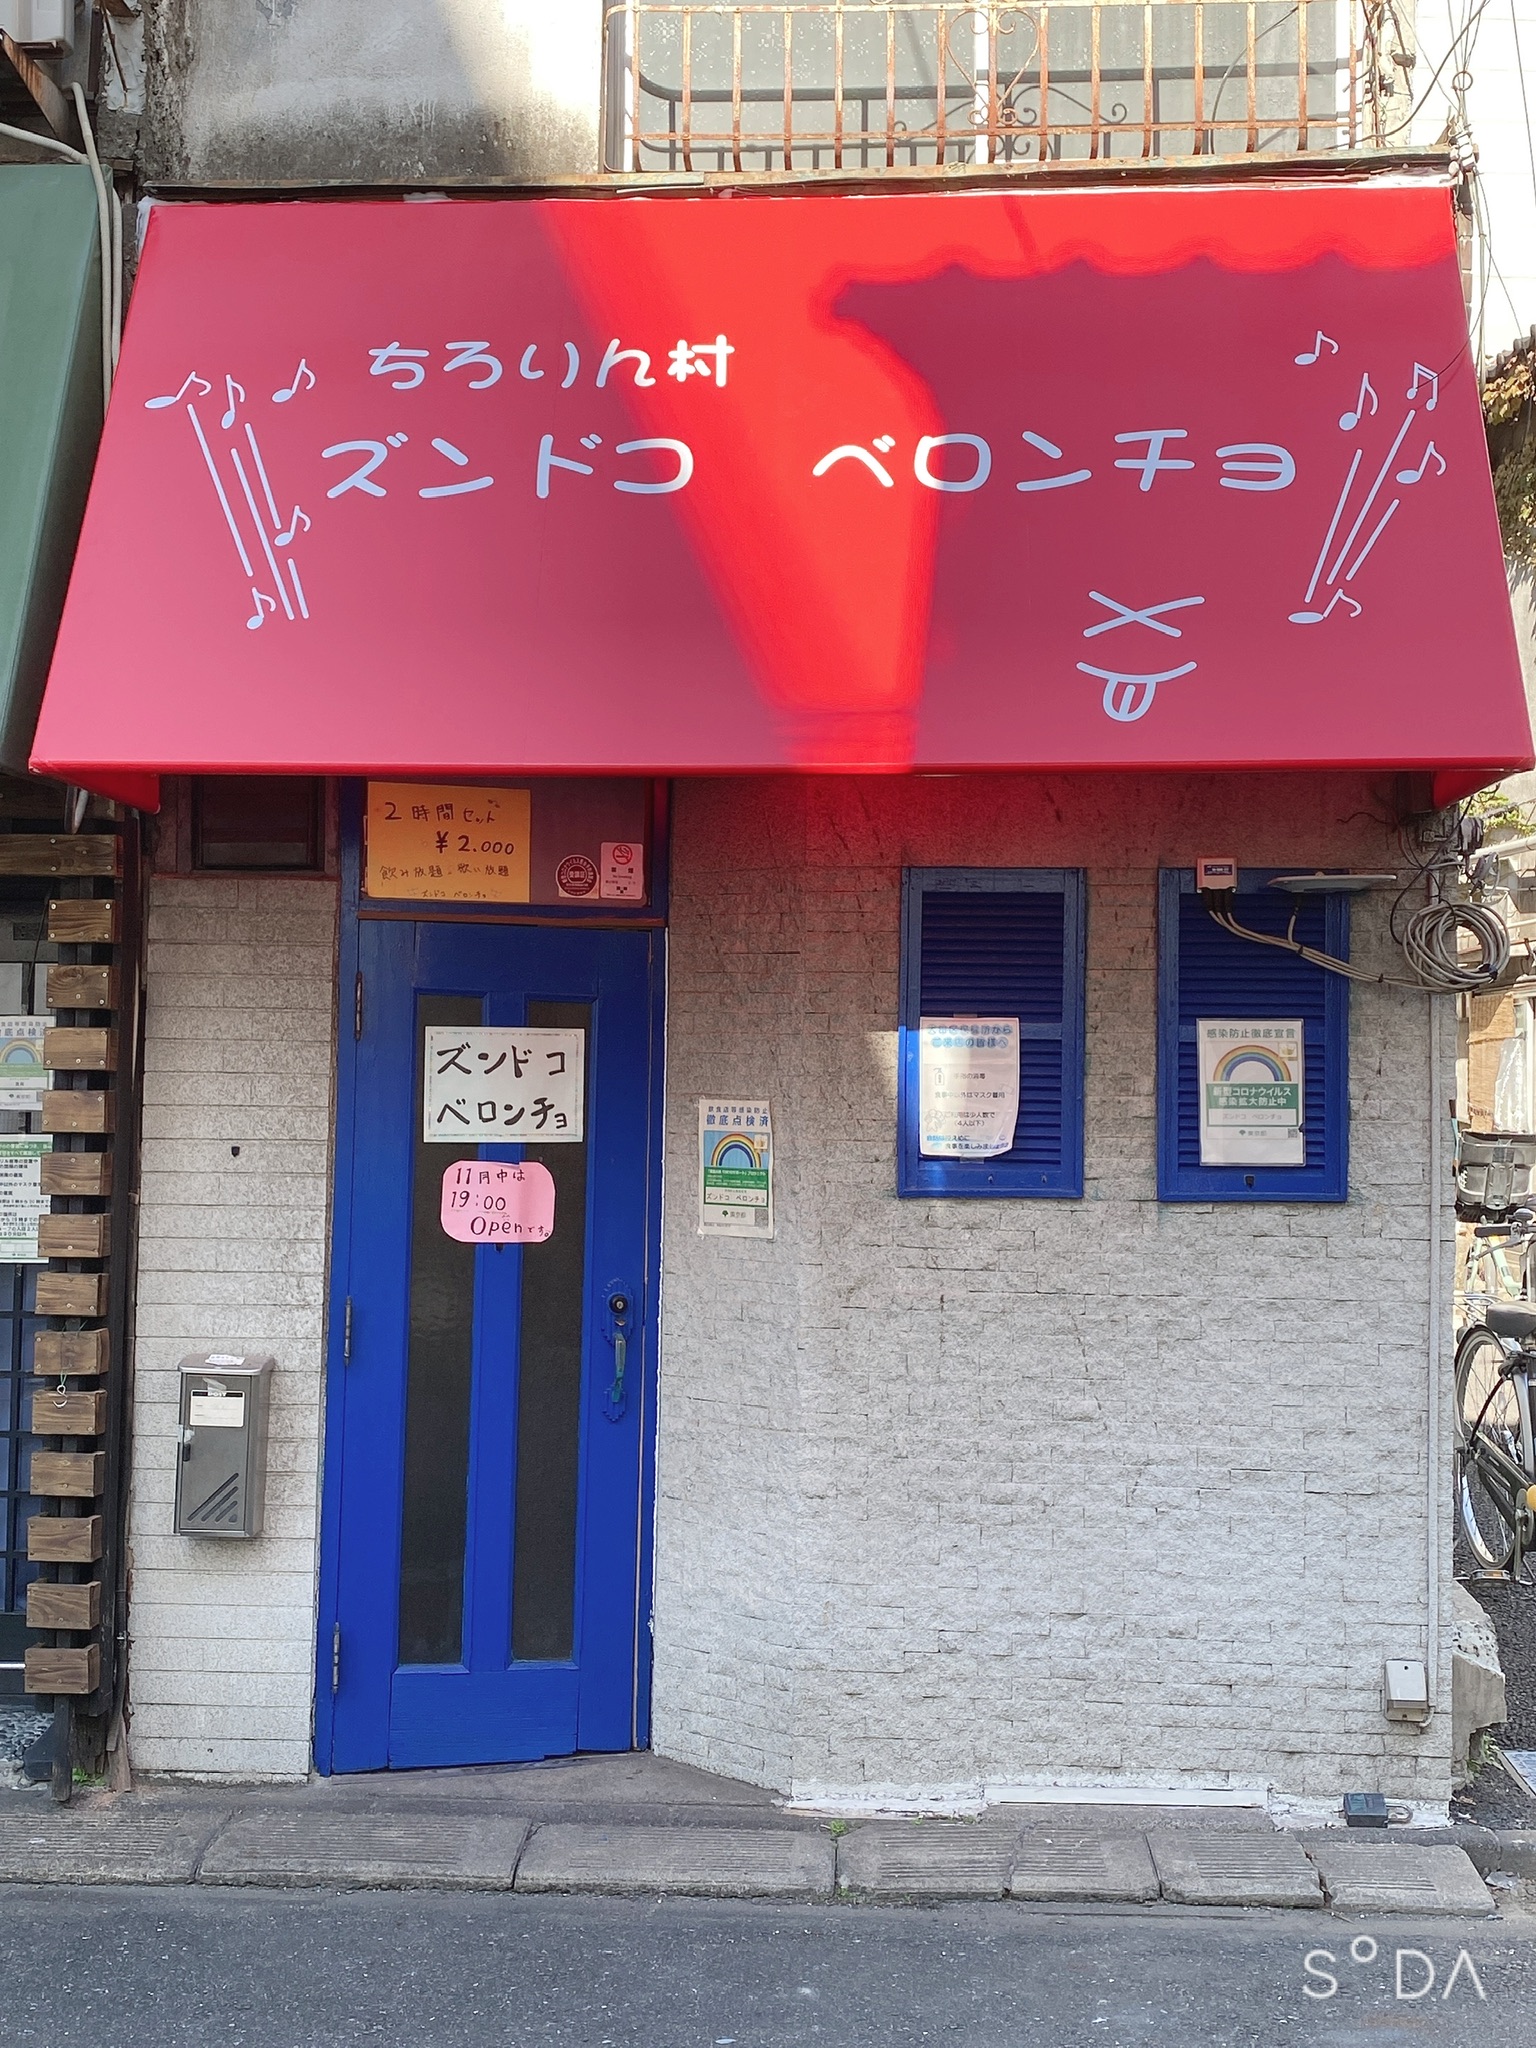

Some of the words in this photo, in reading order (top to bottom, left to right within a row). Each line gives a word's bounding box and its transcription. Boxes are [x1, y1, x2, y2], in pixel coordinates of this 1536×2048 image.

[367, 334, 735, 390] ちろりん村
[321, 432, 695, 500] ズンドコ
[1207, 1028, 1296, 1039] 感染防止徹底宣言
[437, 1042, 566, 1078] ズンドコ
[1213, 1087, 1292, 1096] 新型コロナウイルス
[1218, 1097, 1287, 1106] 感染拡大防止中
[437, 1097, 568, 1130] ベロンチョ
[706, 1114, 769, 1127] 徹底点検済
[455, 1167, 526, 1185] 11月中は
[450, 1191, 506, 1211] 19:00
